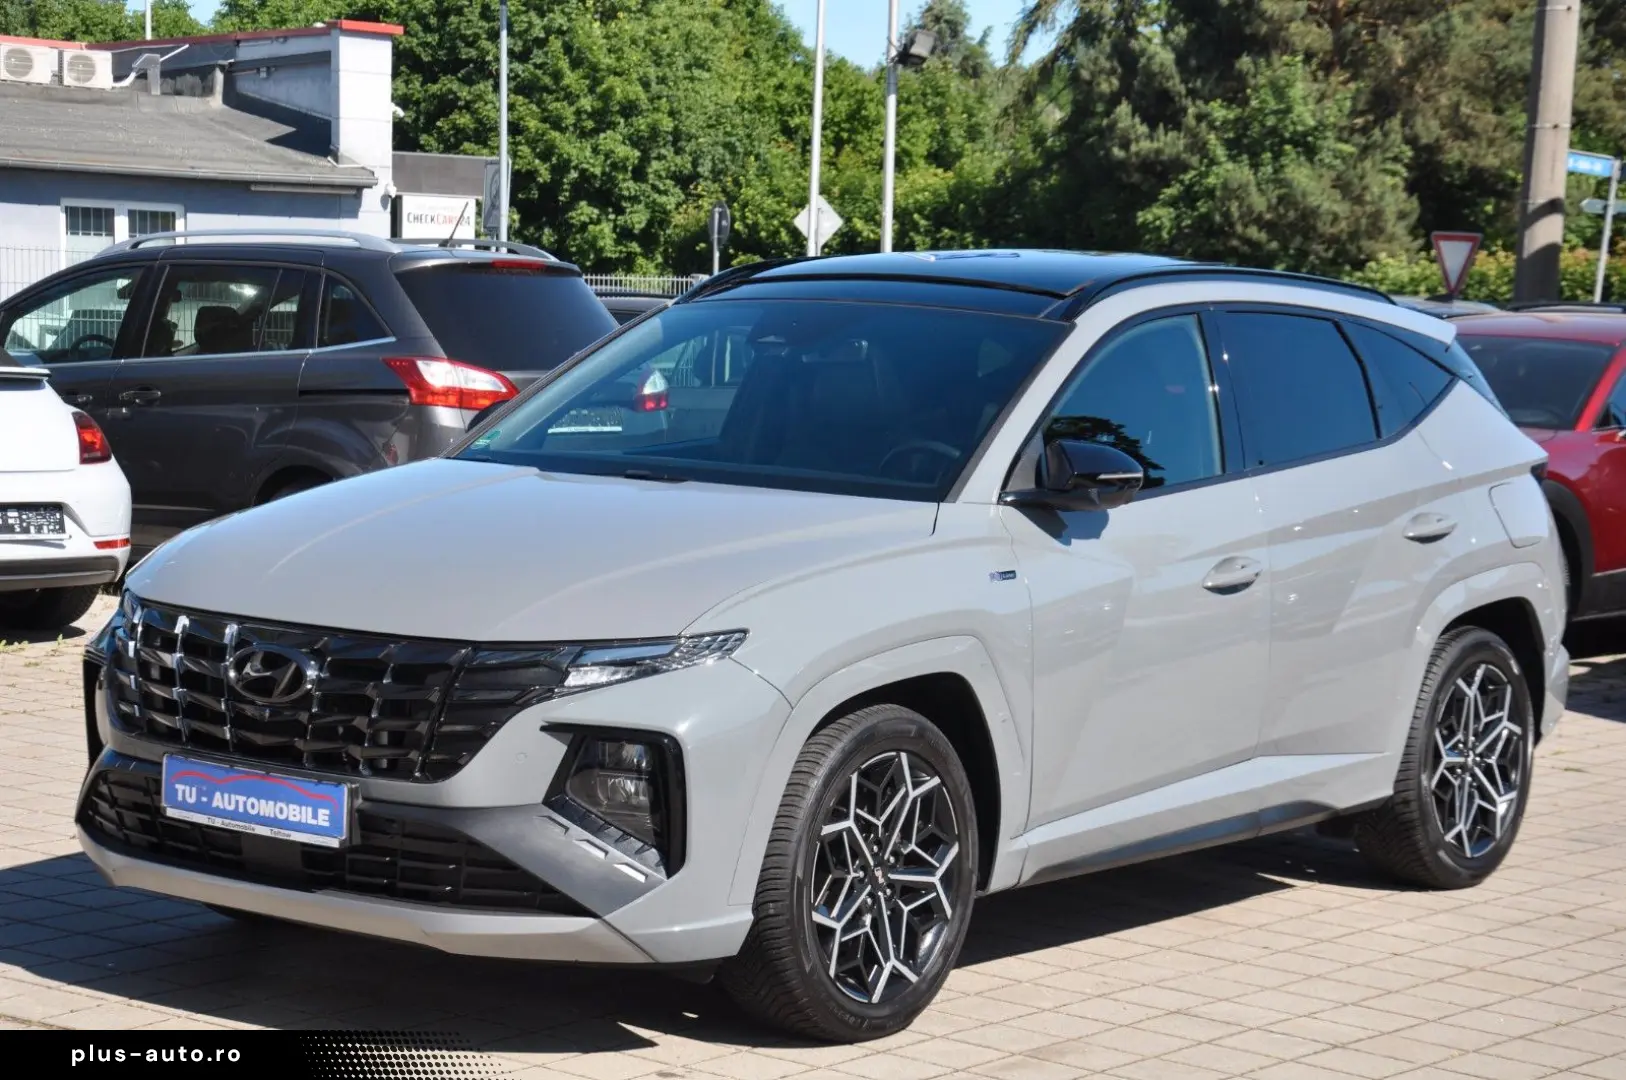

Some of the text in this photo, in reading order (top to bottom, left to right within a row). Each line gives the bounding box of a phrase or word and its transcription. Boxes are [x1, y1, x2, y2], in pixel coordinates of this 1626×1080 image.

[175, 784, 197, 803] TU
[212, 792, 330, 826] AUTOMOBILE
[220, 820, 256, 832] Automobile
